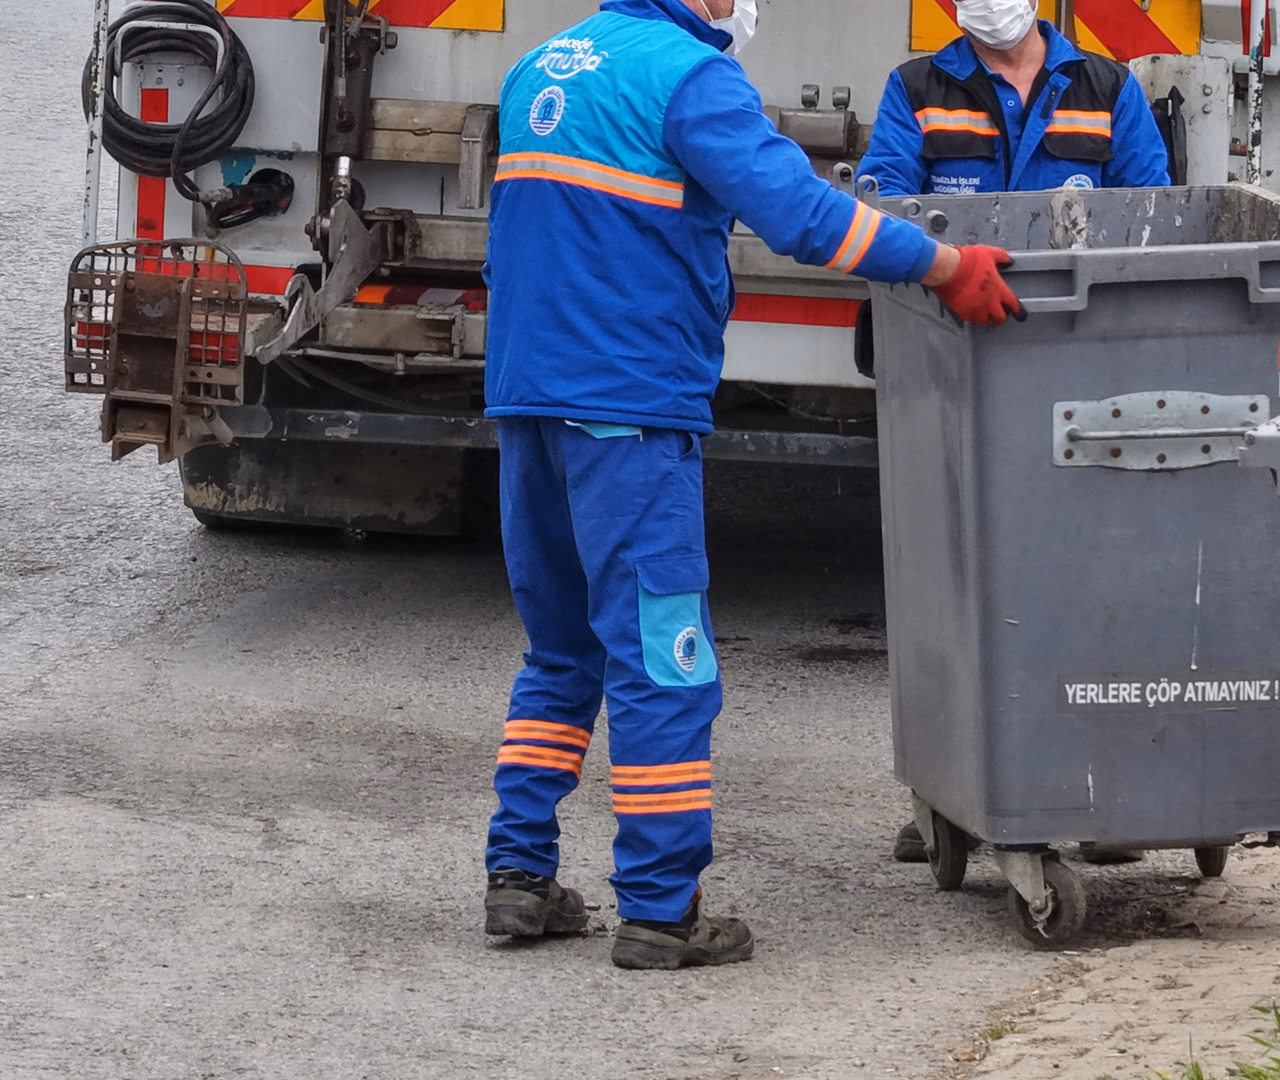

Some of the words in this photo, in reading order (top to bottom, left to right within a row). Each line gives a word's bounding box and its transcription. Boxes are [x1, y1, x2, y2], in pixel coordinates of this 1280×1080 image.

[1065, 683, 1141, 703] YERLERE
[1145, 678, 1181, 707] ÇÖP
[1183, 680, 1270, 702] ATMAYINIZ
